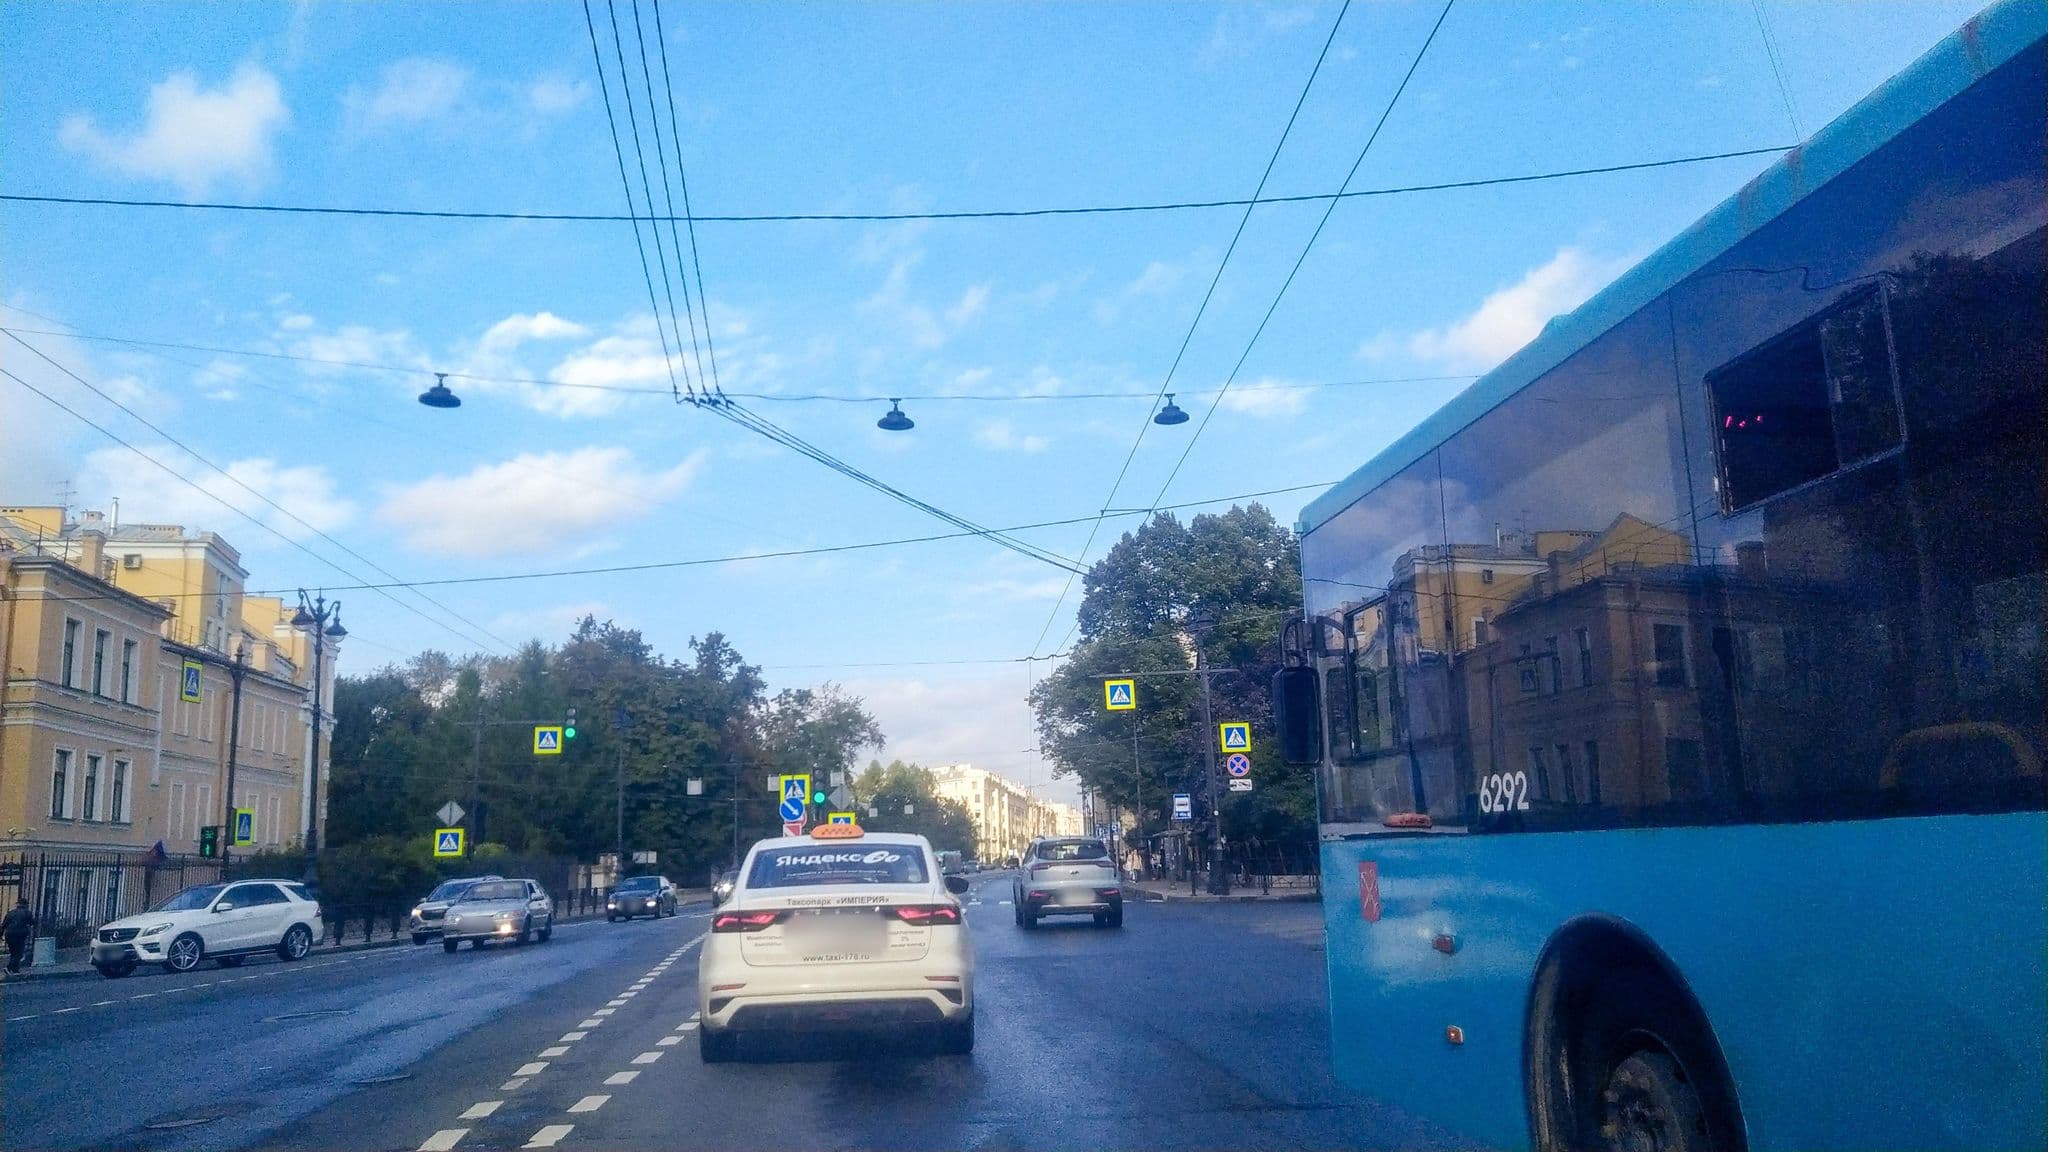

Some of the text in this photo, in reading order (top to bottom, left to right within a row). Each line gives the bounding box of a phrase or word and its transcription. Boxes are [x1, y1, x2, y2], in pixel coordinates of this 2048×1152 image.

[1480, 770, 1529, 813] 6292
[776, 853, 862, 867] Яндекс
[836, 896, 889, 905] «ИМПЕРИЯ»
